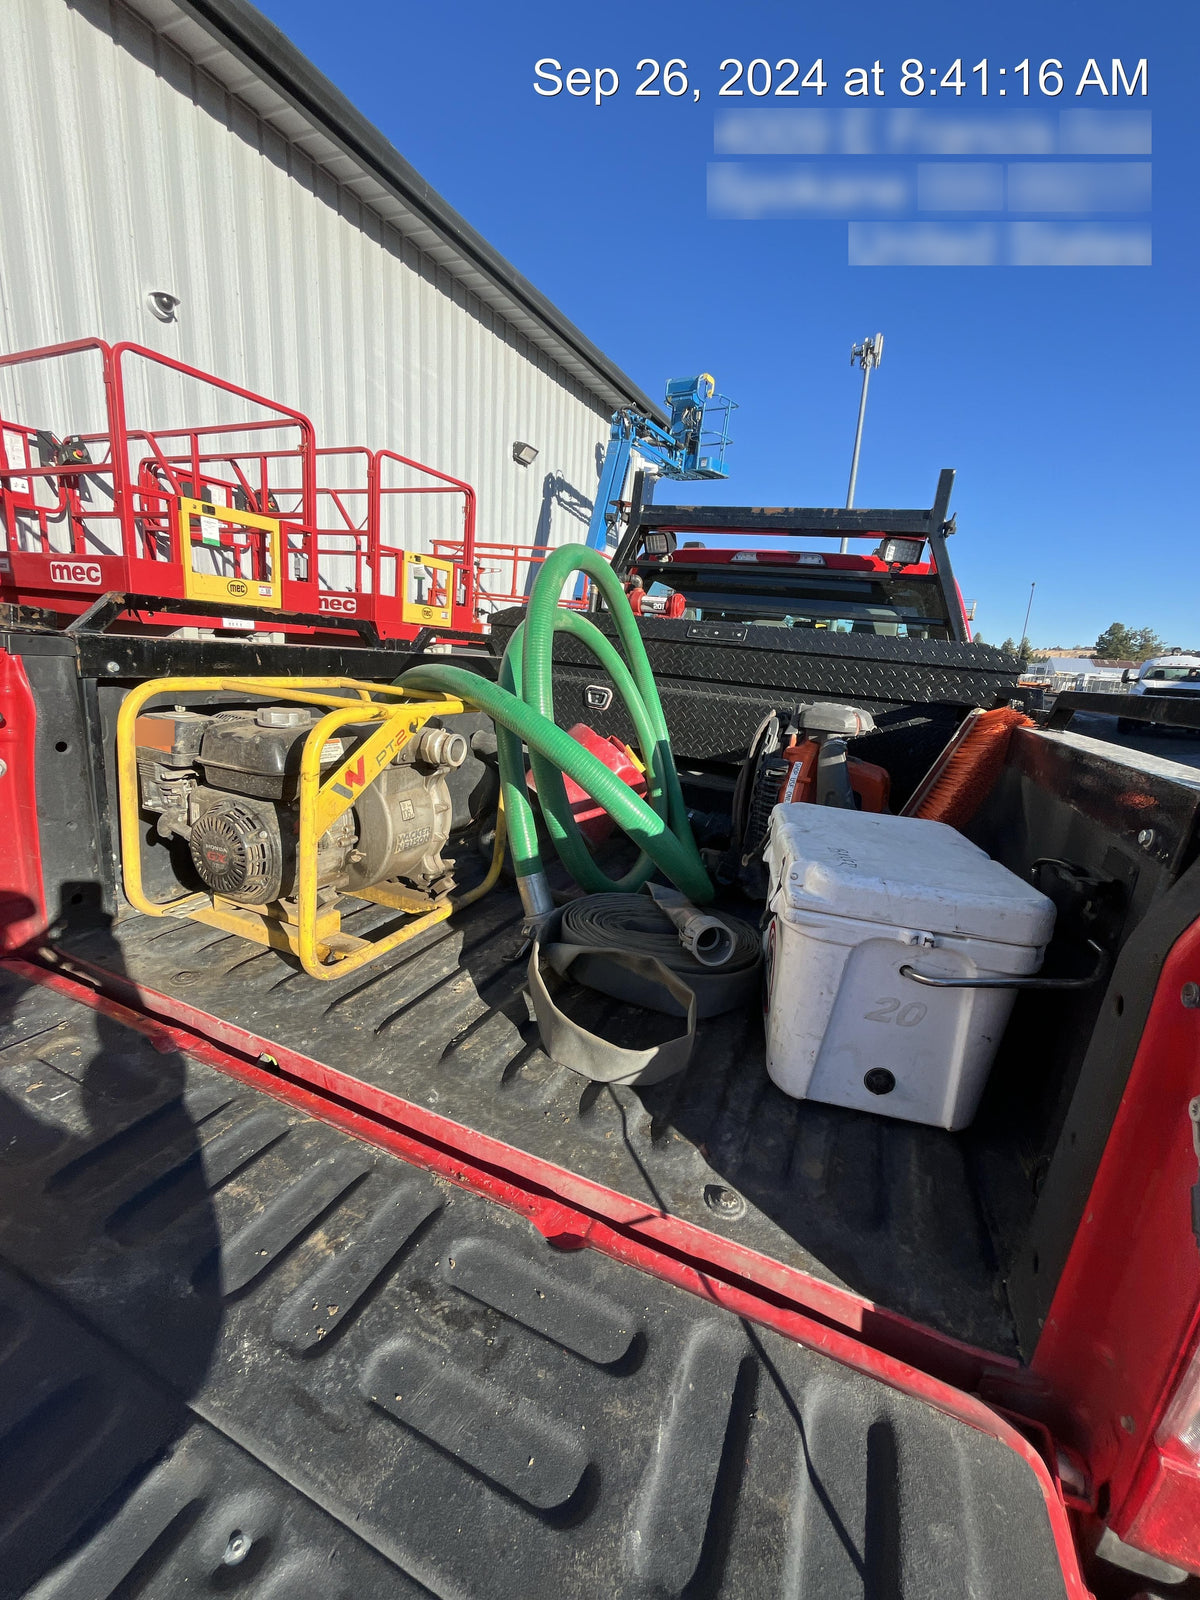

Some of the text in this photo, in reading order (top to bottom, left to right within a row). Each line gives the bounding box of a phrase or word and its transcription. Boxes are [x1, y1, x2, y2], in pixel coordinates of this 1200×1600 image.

[51, 564, 101, 583] mec
[229, 584, 245, 593] mec
[376, 729, 407, 767] PT2
[206, 851, 229, 864] GX
[864, 997, 928, 1028] 20
